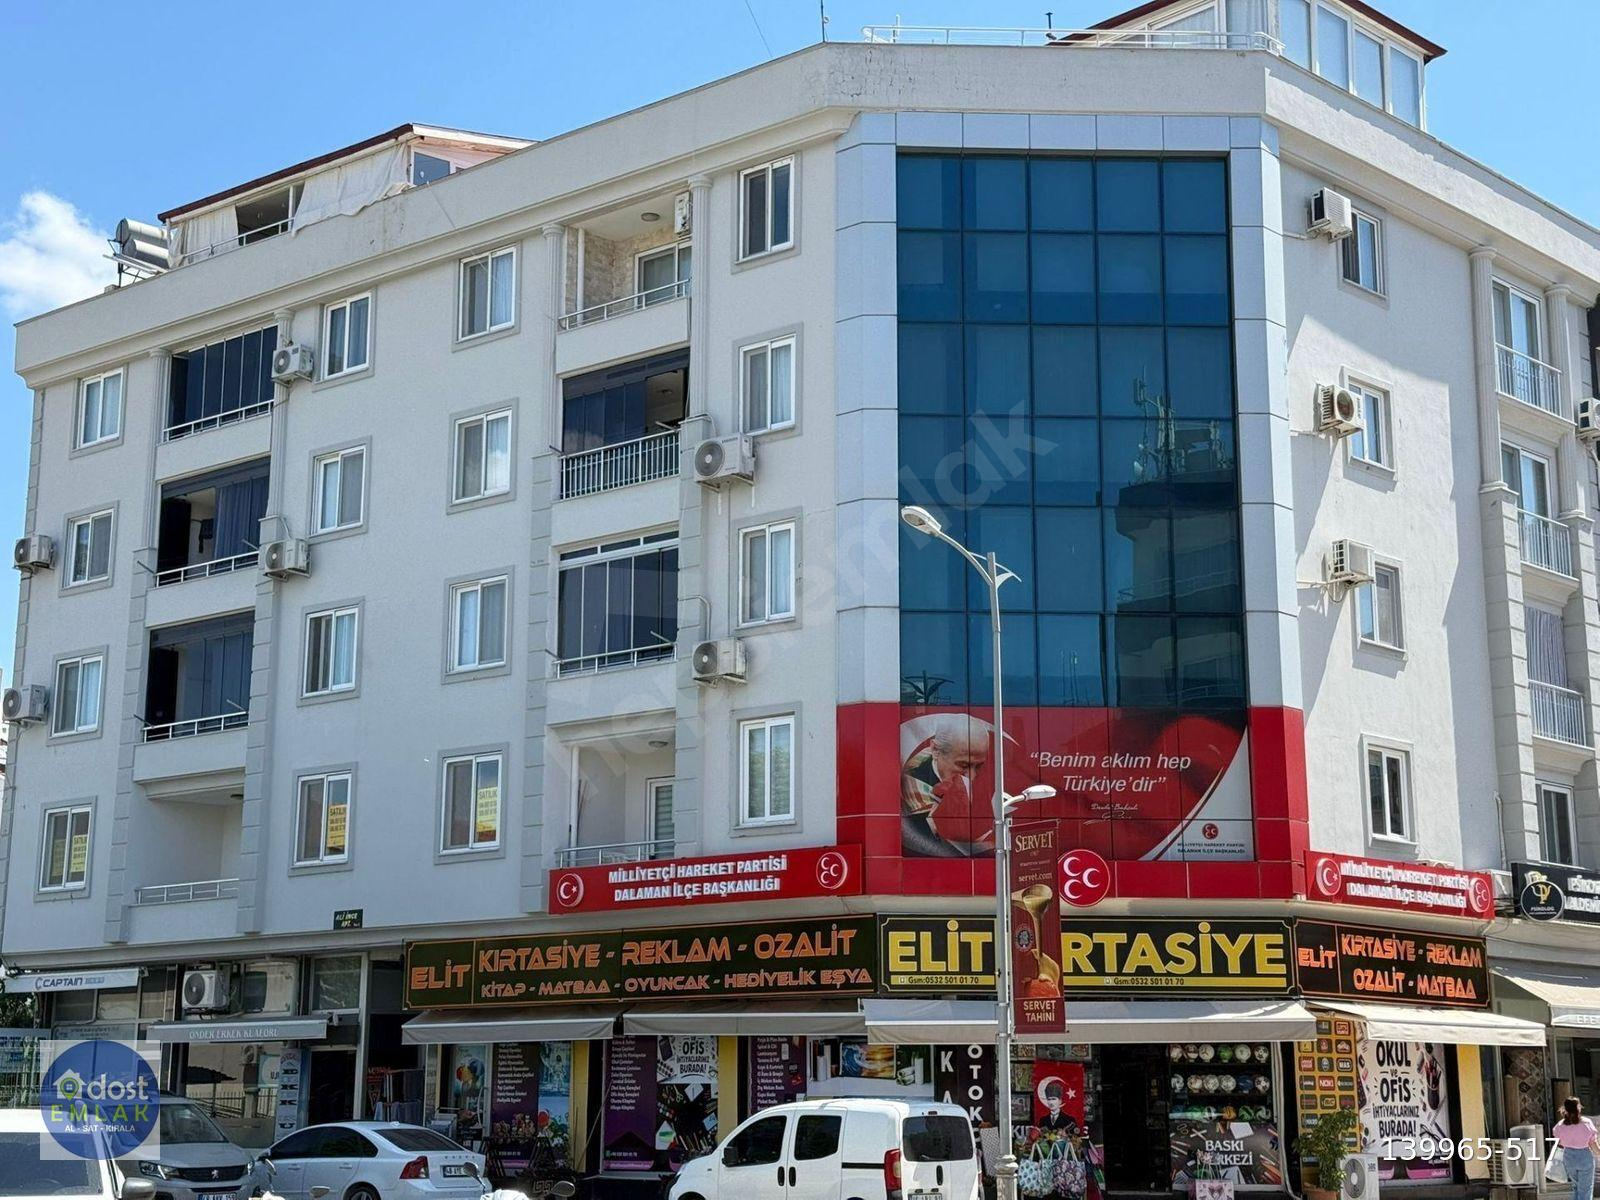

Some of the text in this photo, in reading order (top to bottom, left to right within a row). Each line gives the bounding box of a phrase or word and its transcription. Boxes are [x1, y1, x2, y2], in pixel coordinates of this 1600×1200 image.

[1101, 752, 1151, 769] aklım
[1156, 753, 1192, 772] hep
[1015, 831, 1054, 852] SERVET
[608, 856, 788, 884] MİLLİYETÇİ HAREKET PARTİSİ
[1018, 872, 1052, 882] servet.com
[614, 874, 780, 902] DALAMAN İLÇE BAŞKANLIĞI
[478, 940, 601, 974] KIRTASİYE
[622, 936, 732, 966] REKLAM
[754, 923, 857, 960] OZALİT
[888, 919, 993, 972] ELİT
[1061, 921, 1287, 974] RTASİYE
[1341, 934, 1416, 962] KIRTASİYE
[1426, 942, 1482, 968] REKLAM
[1298, 944, 1336, 970] ELİT
[411, 959, 471, 990] ELİT
[481, 980, 526, 998] KİTAP
[538, 979, 611, 996] MATBAA
[624, 974, 710, 992] OYUNCAK
[724, 967, 816, 989] HEDİYELİK
[820, 968, 872, 989] EŞYA
[908, 976, 944, 984] Gsm:0532
[944, 976, 958, 984] 501
[970, 976, 979, 984] 70
[1114, 977, 1184, 986] Gsm:0532 501 01 70
[1353, 966, 1406, 993] OZALİT
[1417, 974, 1477, 1000] MATBAA
[1023, 1000, 1056, 1012] SERVET
[1025, 1011, 1055, 1022] TAHİNİ
[682, 1041, 704, 1055] OFİS
[1376, 1040, 1411, 1068] OKUL
[680, 1063, 706, 1074] BURADA!
[1390, 1068, 1398, 1078] ve
[1380, 1077, 1412, 1103] OFİS
[1373, 1104, 1420, 1120] İHTİYAÇLARINIZ
[1379, 1120, 1416, 1138] BURADA!
[1205, 1140, 1244, 1152] BASKI
